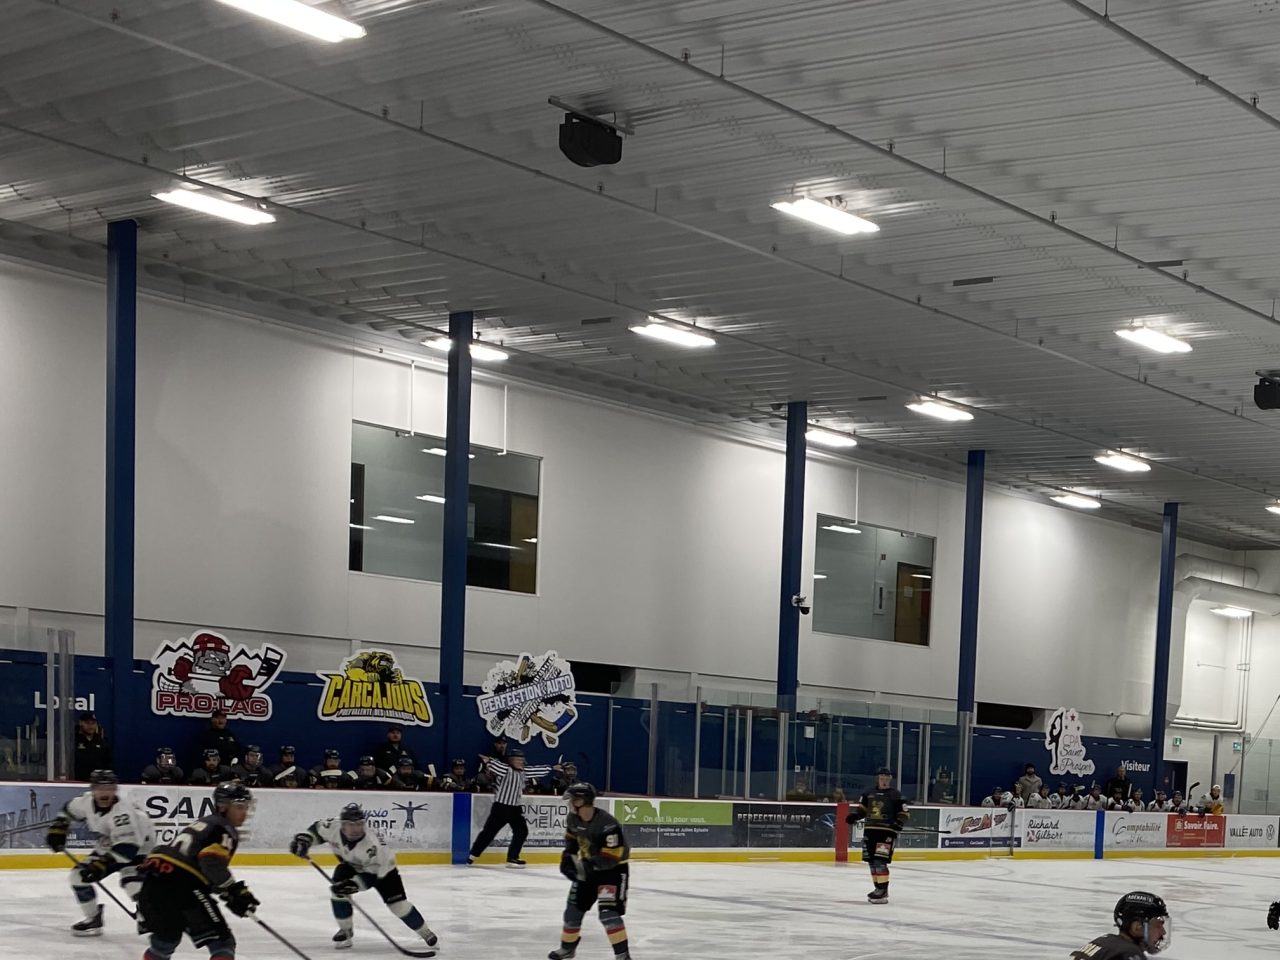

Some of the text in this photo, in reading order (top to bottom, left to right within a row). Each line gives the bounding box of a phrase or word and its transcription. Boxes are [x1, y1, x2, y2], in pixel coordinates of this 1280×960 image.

[34, 691, 95, 711] Lal
[321, 675, 431, 723] CARCAJOUS
[481, 674, 573, 715] PERFECTION AUTO
[1121, 759, 1151, 772] Visiteur
[1028, 819, 1060, 830] Richard
[1249, 828, 1263, 838] AUTO
